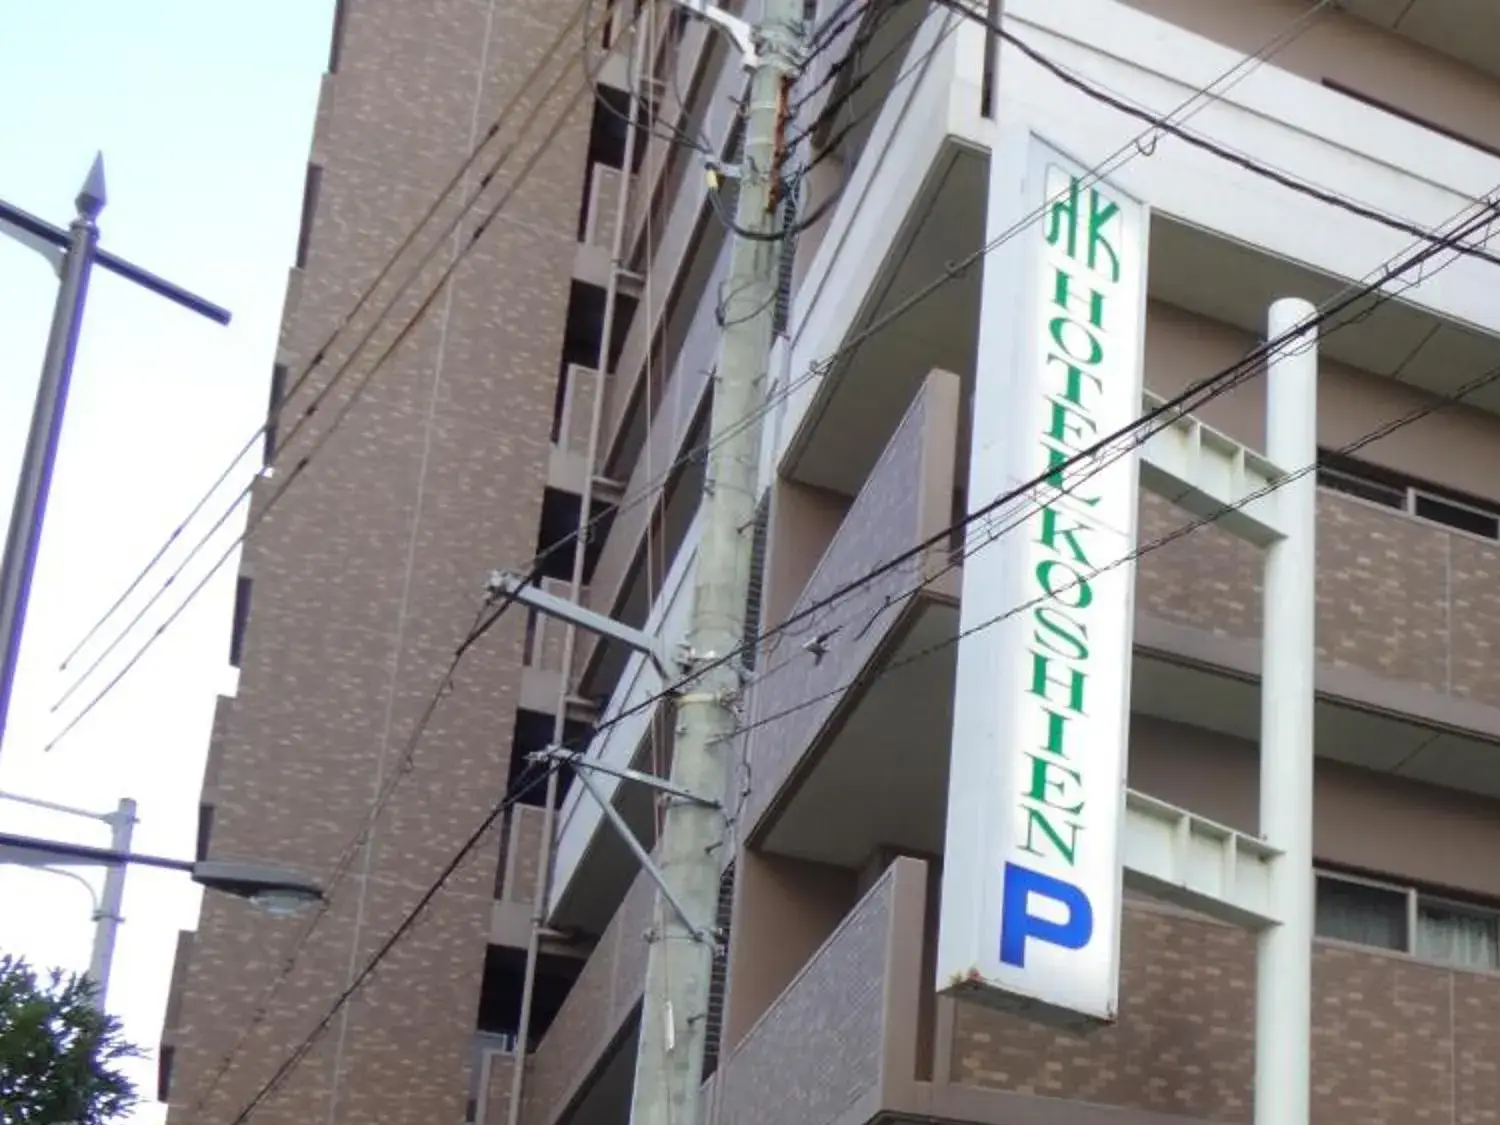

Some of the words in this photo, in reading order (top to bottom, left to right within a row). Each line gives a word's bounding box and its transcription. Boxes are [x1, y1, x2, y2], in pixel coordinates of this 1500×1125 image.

[1040, 266, 1107, 506] HOTEL
[1017, 504, 1098, 867] KOSHIEN
[1000, 861, 1094, 969] P
